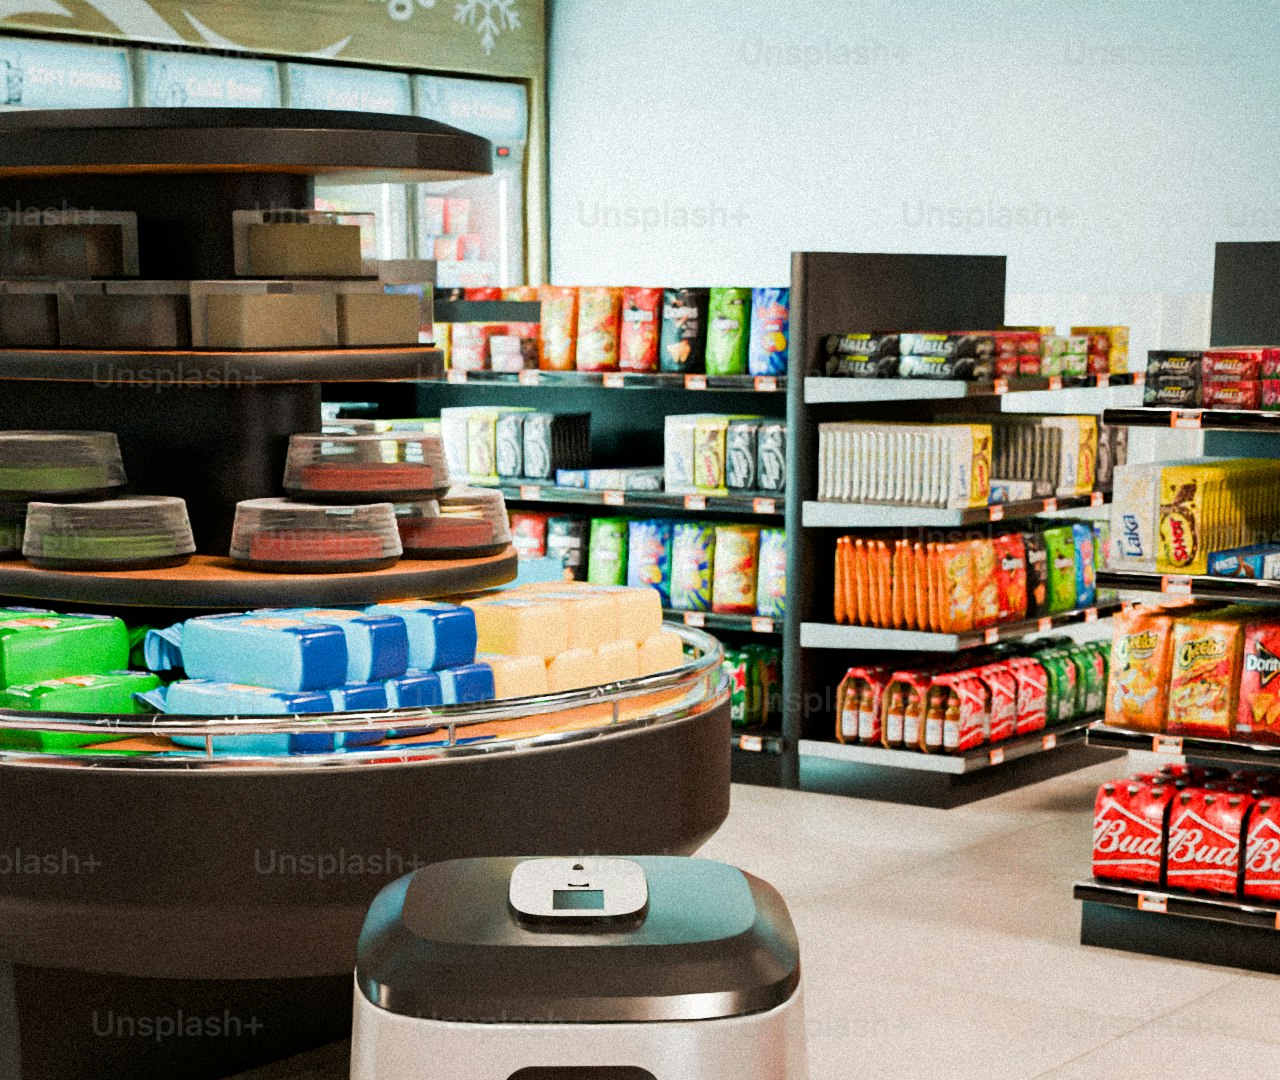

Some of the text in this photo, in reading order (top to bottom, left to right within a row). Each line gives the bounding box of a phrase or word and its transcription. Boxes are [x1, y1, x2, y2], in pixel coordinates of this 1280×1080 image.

[1125, 514, 1144, 558] Laka
[1093, 818, 1163, 857] Bud
[1168, 827, 1240, 867] Bud
